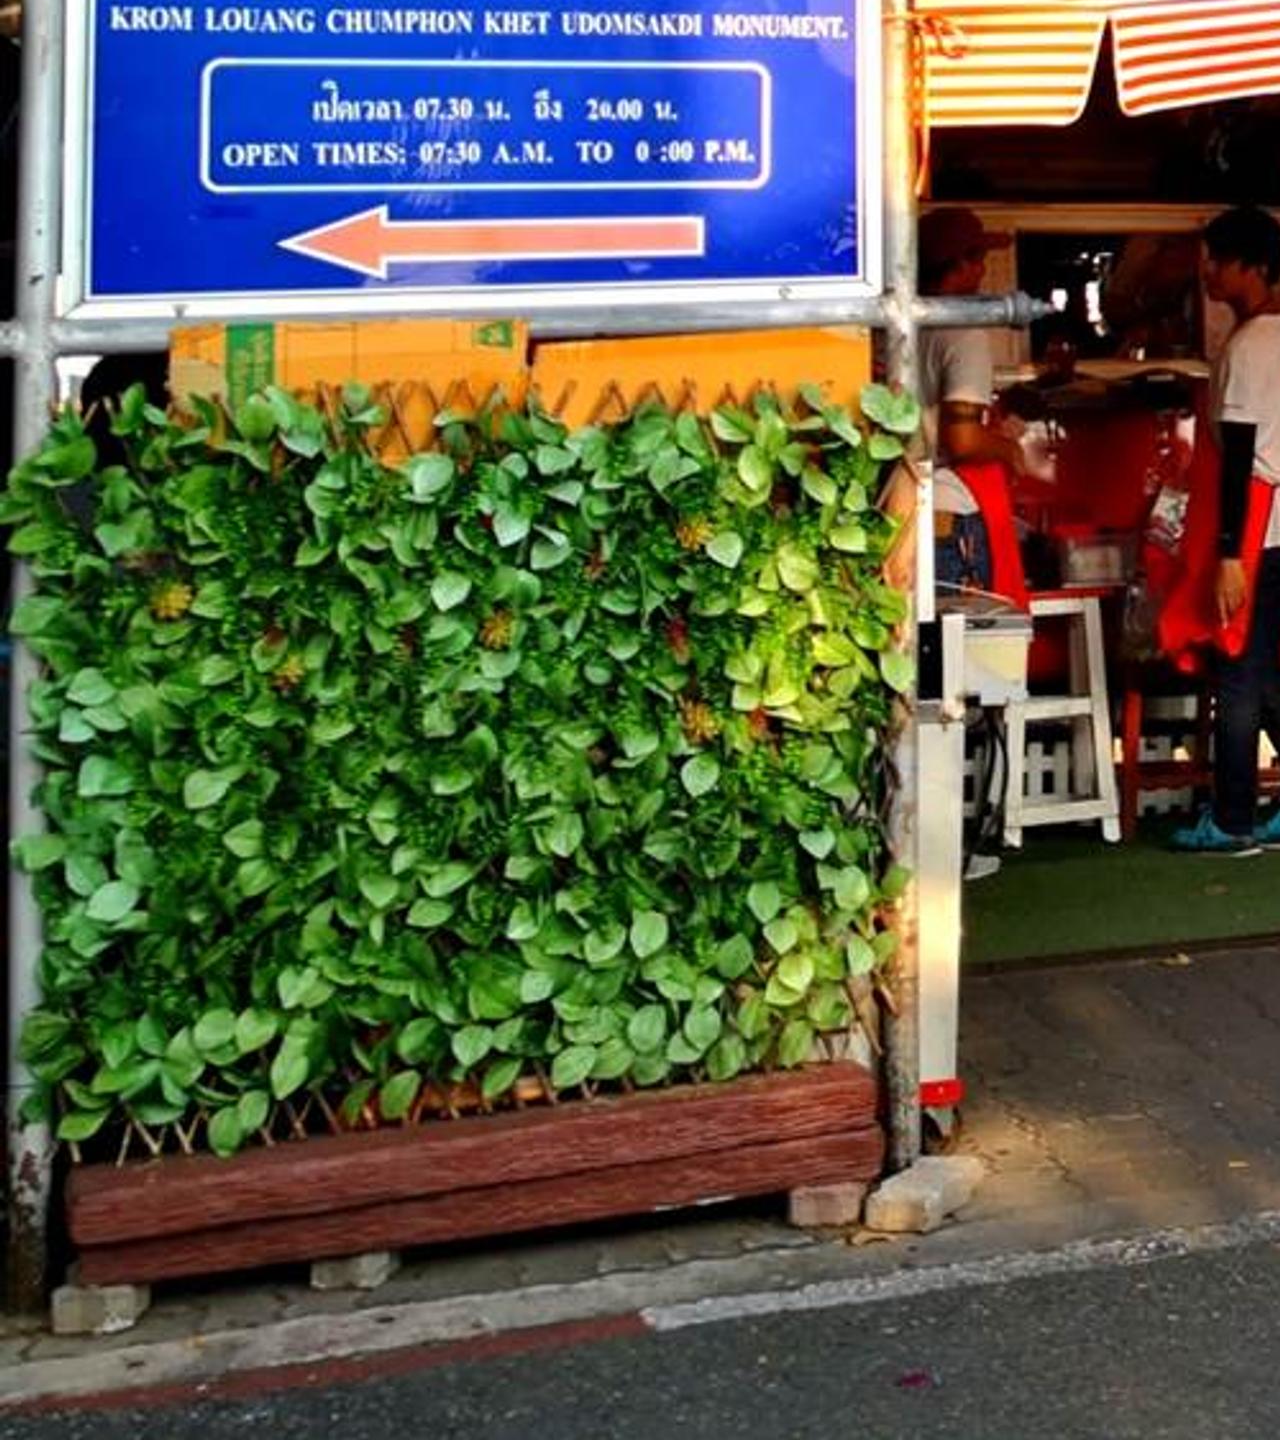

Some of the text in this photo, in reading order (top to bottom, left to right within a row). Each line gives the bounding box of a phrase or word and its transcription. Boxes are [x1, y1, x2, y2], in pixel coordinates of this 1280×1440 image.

[110, 6, 849, 39] KROM LOUANG CHUMPHON KHET UDOMSAKDI MONUMENT.
[312, 79, 402, 122] เปิดเวลา
[413, 97, 474, 121] 07.30
[533, 88, 564, 122] ถึง
[222, 143, 300, 167] OPEN
[313, 141, 407, 165] TIMES:
[418, 141, 482, 164] 07:30
[492, 141, 554, 164] A.M.
[576, 141, 615, 164] TO
[704, 139, 756, 164] P.M.
